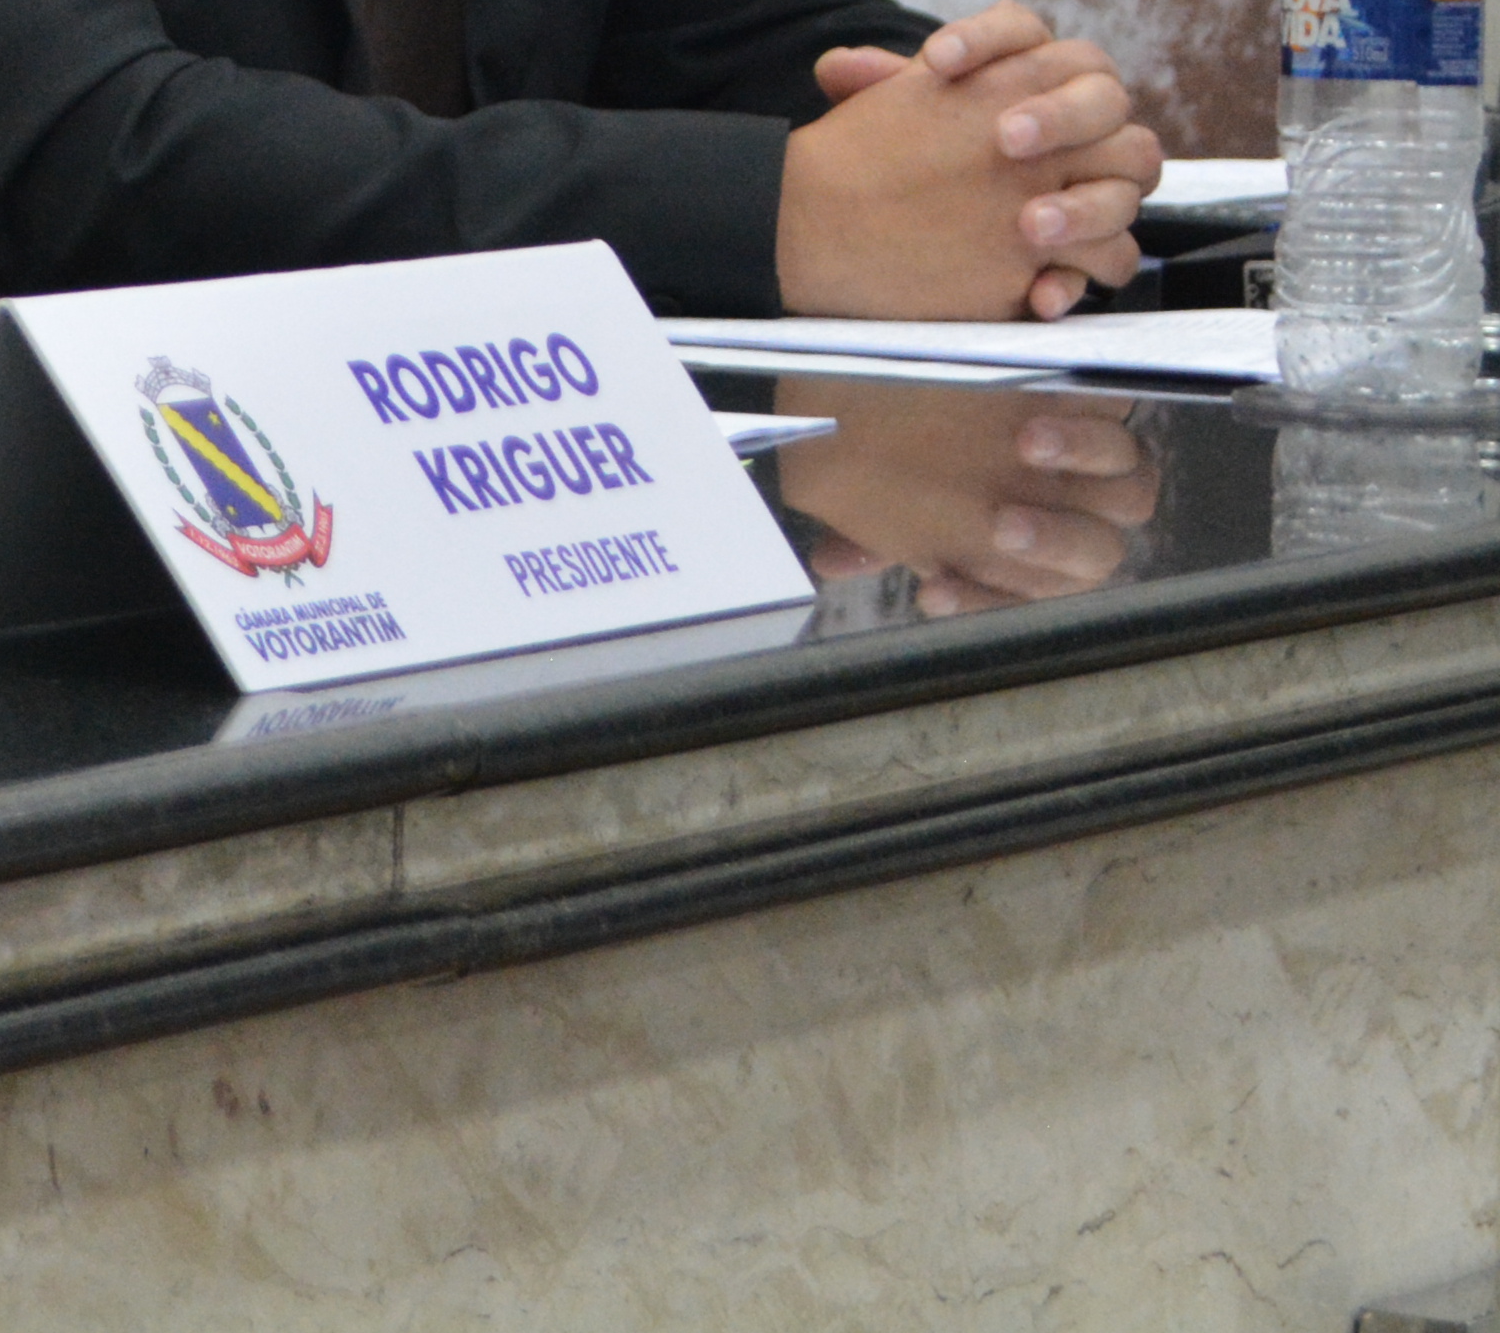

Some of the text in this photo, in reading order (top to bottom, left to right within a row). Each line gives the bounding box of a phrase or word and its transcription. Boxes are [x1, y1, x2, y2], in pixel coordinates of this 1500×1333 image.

[346, 332, 599, 425] RODRIGO
[411, 421, 655, 515] KRIGUER
[237, 534, 306, 560] VOTORANTIM
[503, 530, 680, 598] PRESIDENTE
[235, 591, 388, 632] CÂMARA MUNICIPAL DE
[243, 610, 408, 663] VOTORANTIM
